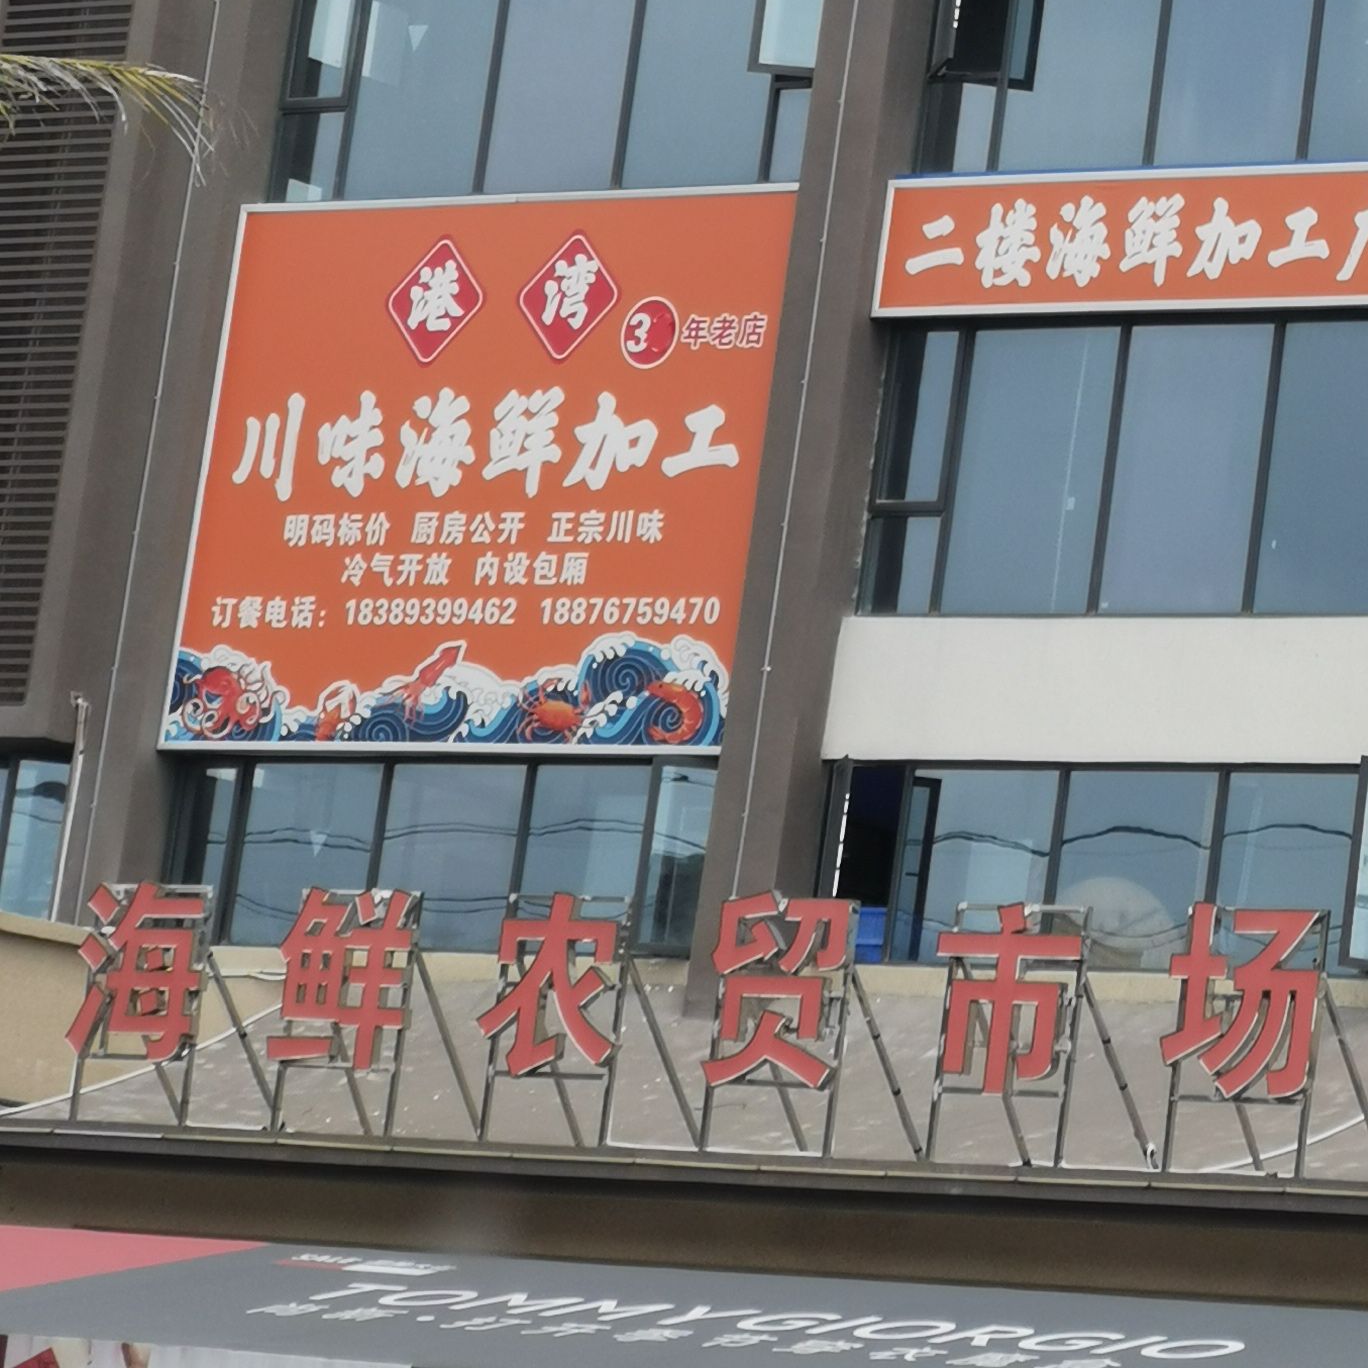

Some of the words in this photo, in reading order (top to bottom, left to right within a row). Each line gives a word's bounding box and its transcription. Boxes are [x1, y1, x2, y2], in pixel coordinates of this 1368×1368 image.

[406, 253, 599, 332] 港湾
[230, 385, 741, 503] 川味海鲜加工
[282, 511, 391, 548] 明码标价
[409, 509, 525, 547] 厨房公开
[546, 508, 664, 545] 正宗川味
[340, 551, 452, 588] 冷气开放
[473, 550, 589, 587] 内设包厢
[344, 596, 518, 627] 18389399462
[540, 595, 722, 626] 18876759470
[66, 881, 1320, 1099] 海鲜农贸市场
[309, 1282, 1246, 1360] TOMMYGIORGIO
